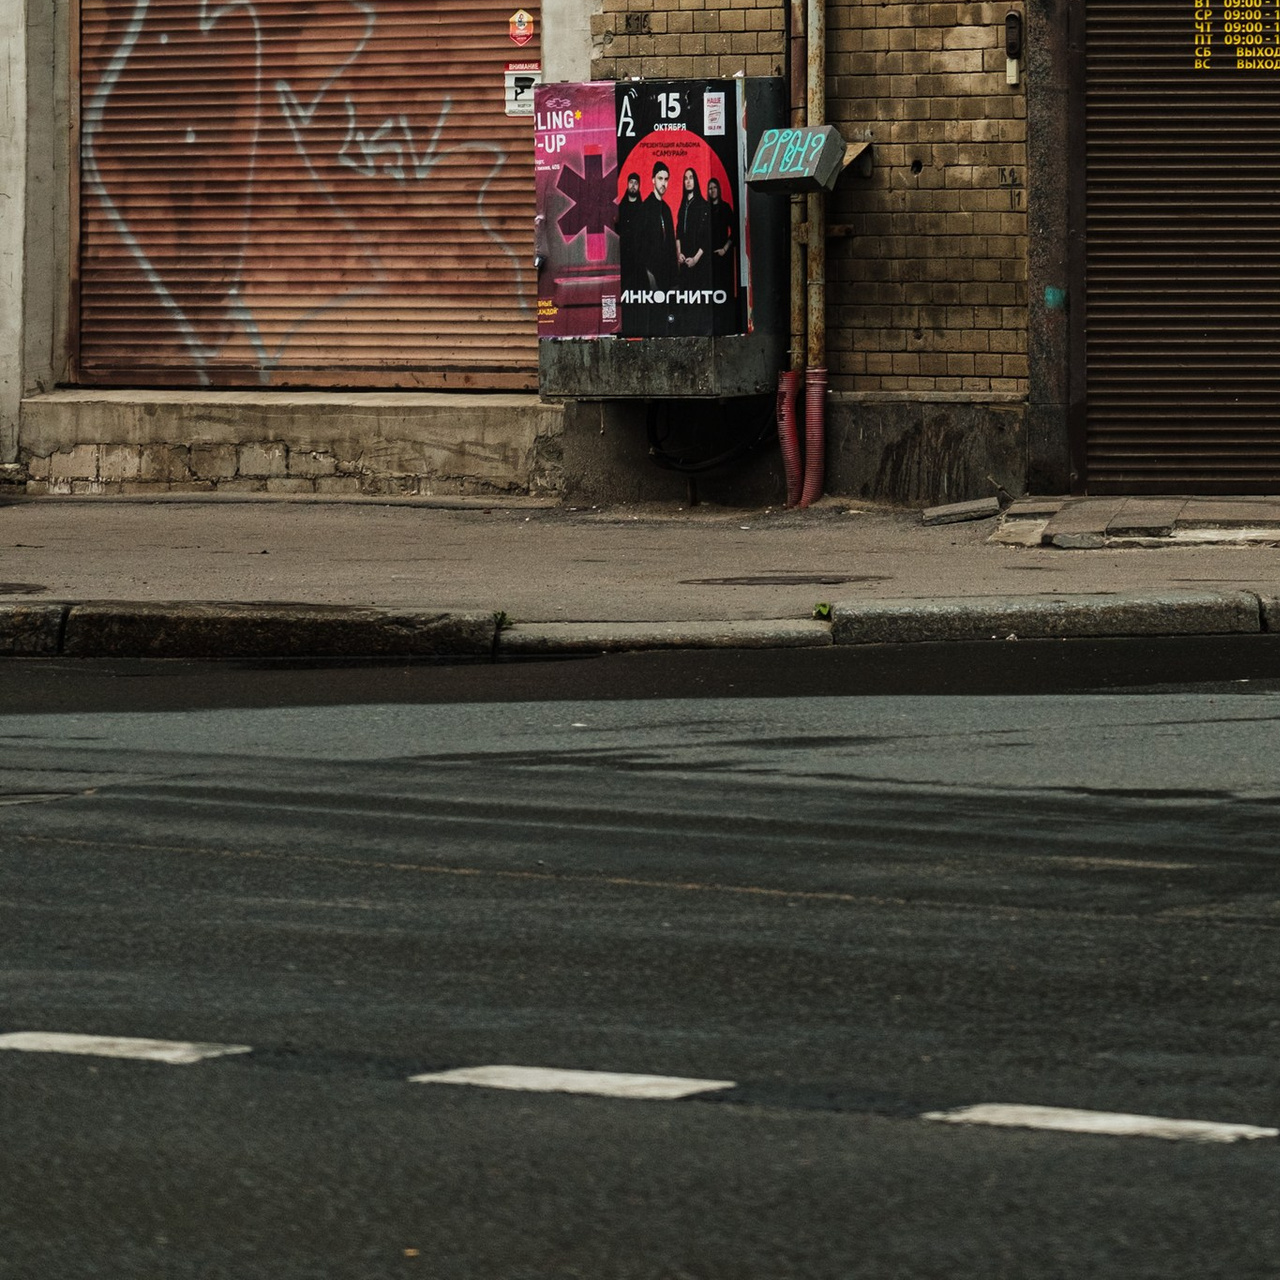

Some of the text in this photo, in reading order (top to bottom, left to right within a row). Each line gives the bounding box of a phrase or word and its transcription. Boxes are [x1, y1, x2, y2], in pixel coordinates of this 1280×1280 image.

[1194, 10, 1212, 20] СР
[1224, 10, 1262, 20] 09:00
[1194, 22, 1213, 32] ЧТ
[1224, 22, 1262, 32] 09:00
[1194, 34, 1213, 45] ПТ
[1224, 34, 1262, 45] 09:00
[1195, 47, 1212, 57] СБ
[1194, 59, 1211, 70] ВС
[657, 92, 681, 118] 15
[534, 110, 574, 131] LING
[654, 122, 687, 132] ОКТЯБРЯ
[652, 149, 688, 157] «САМУРАЙ»
[620, 290, 727, 304] ИНКОГНИТО
